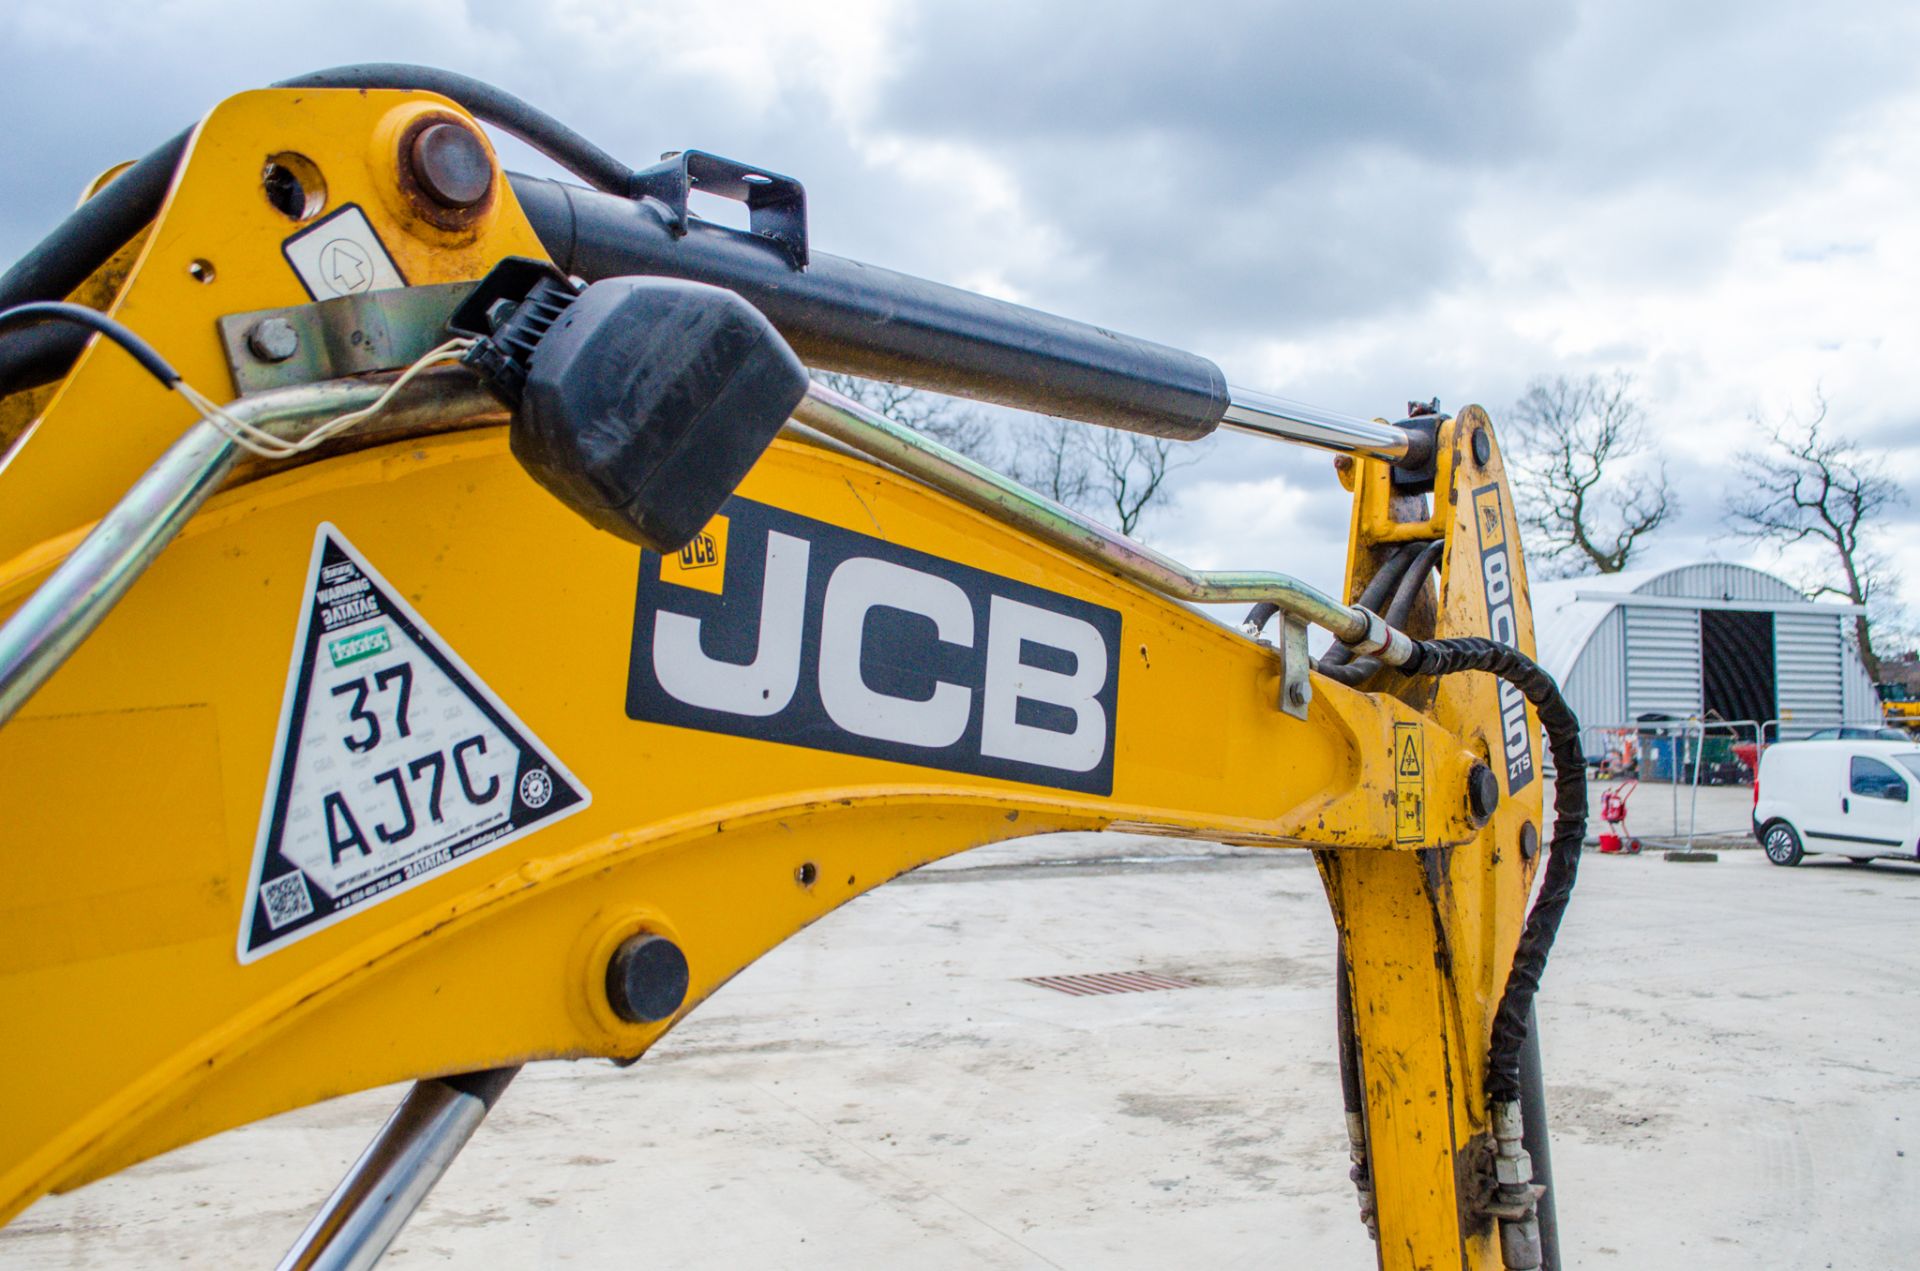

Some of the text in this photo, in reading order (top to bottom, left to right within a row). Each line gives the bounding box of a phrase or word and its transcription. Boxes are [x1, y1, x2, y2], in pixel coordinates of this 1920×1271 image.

[681, 533, 716, 565] JCB
[316, 577, 371, 605] WARNING
[652, 529, 1108, 773] JCB
[331, 661, 414, 753] 37
[1508, 752, 1531, 781] ZTS
[323, 734, 500, 866] AJ7C
